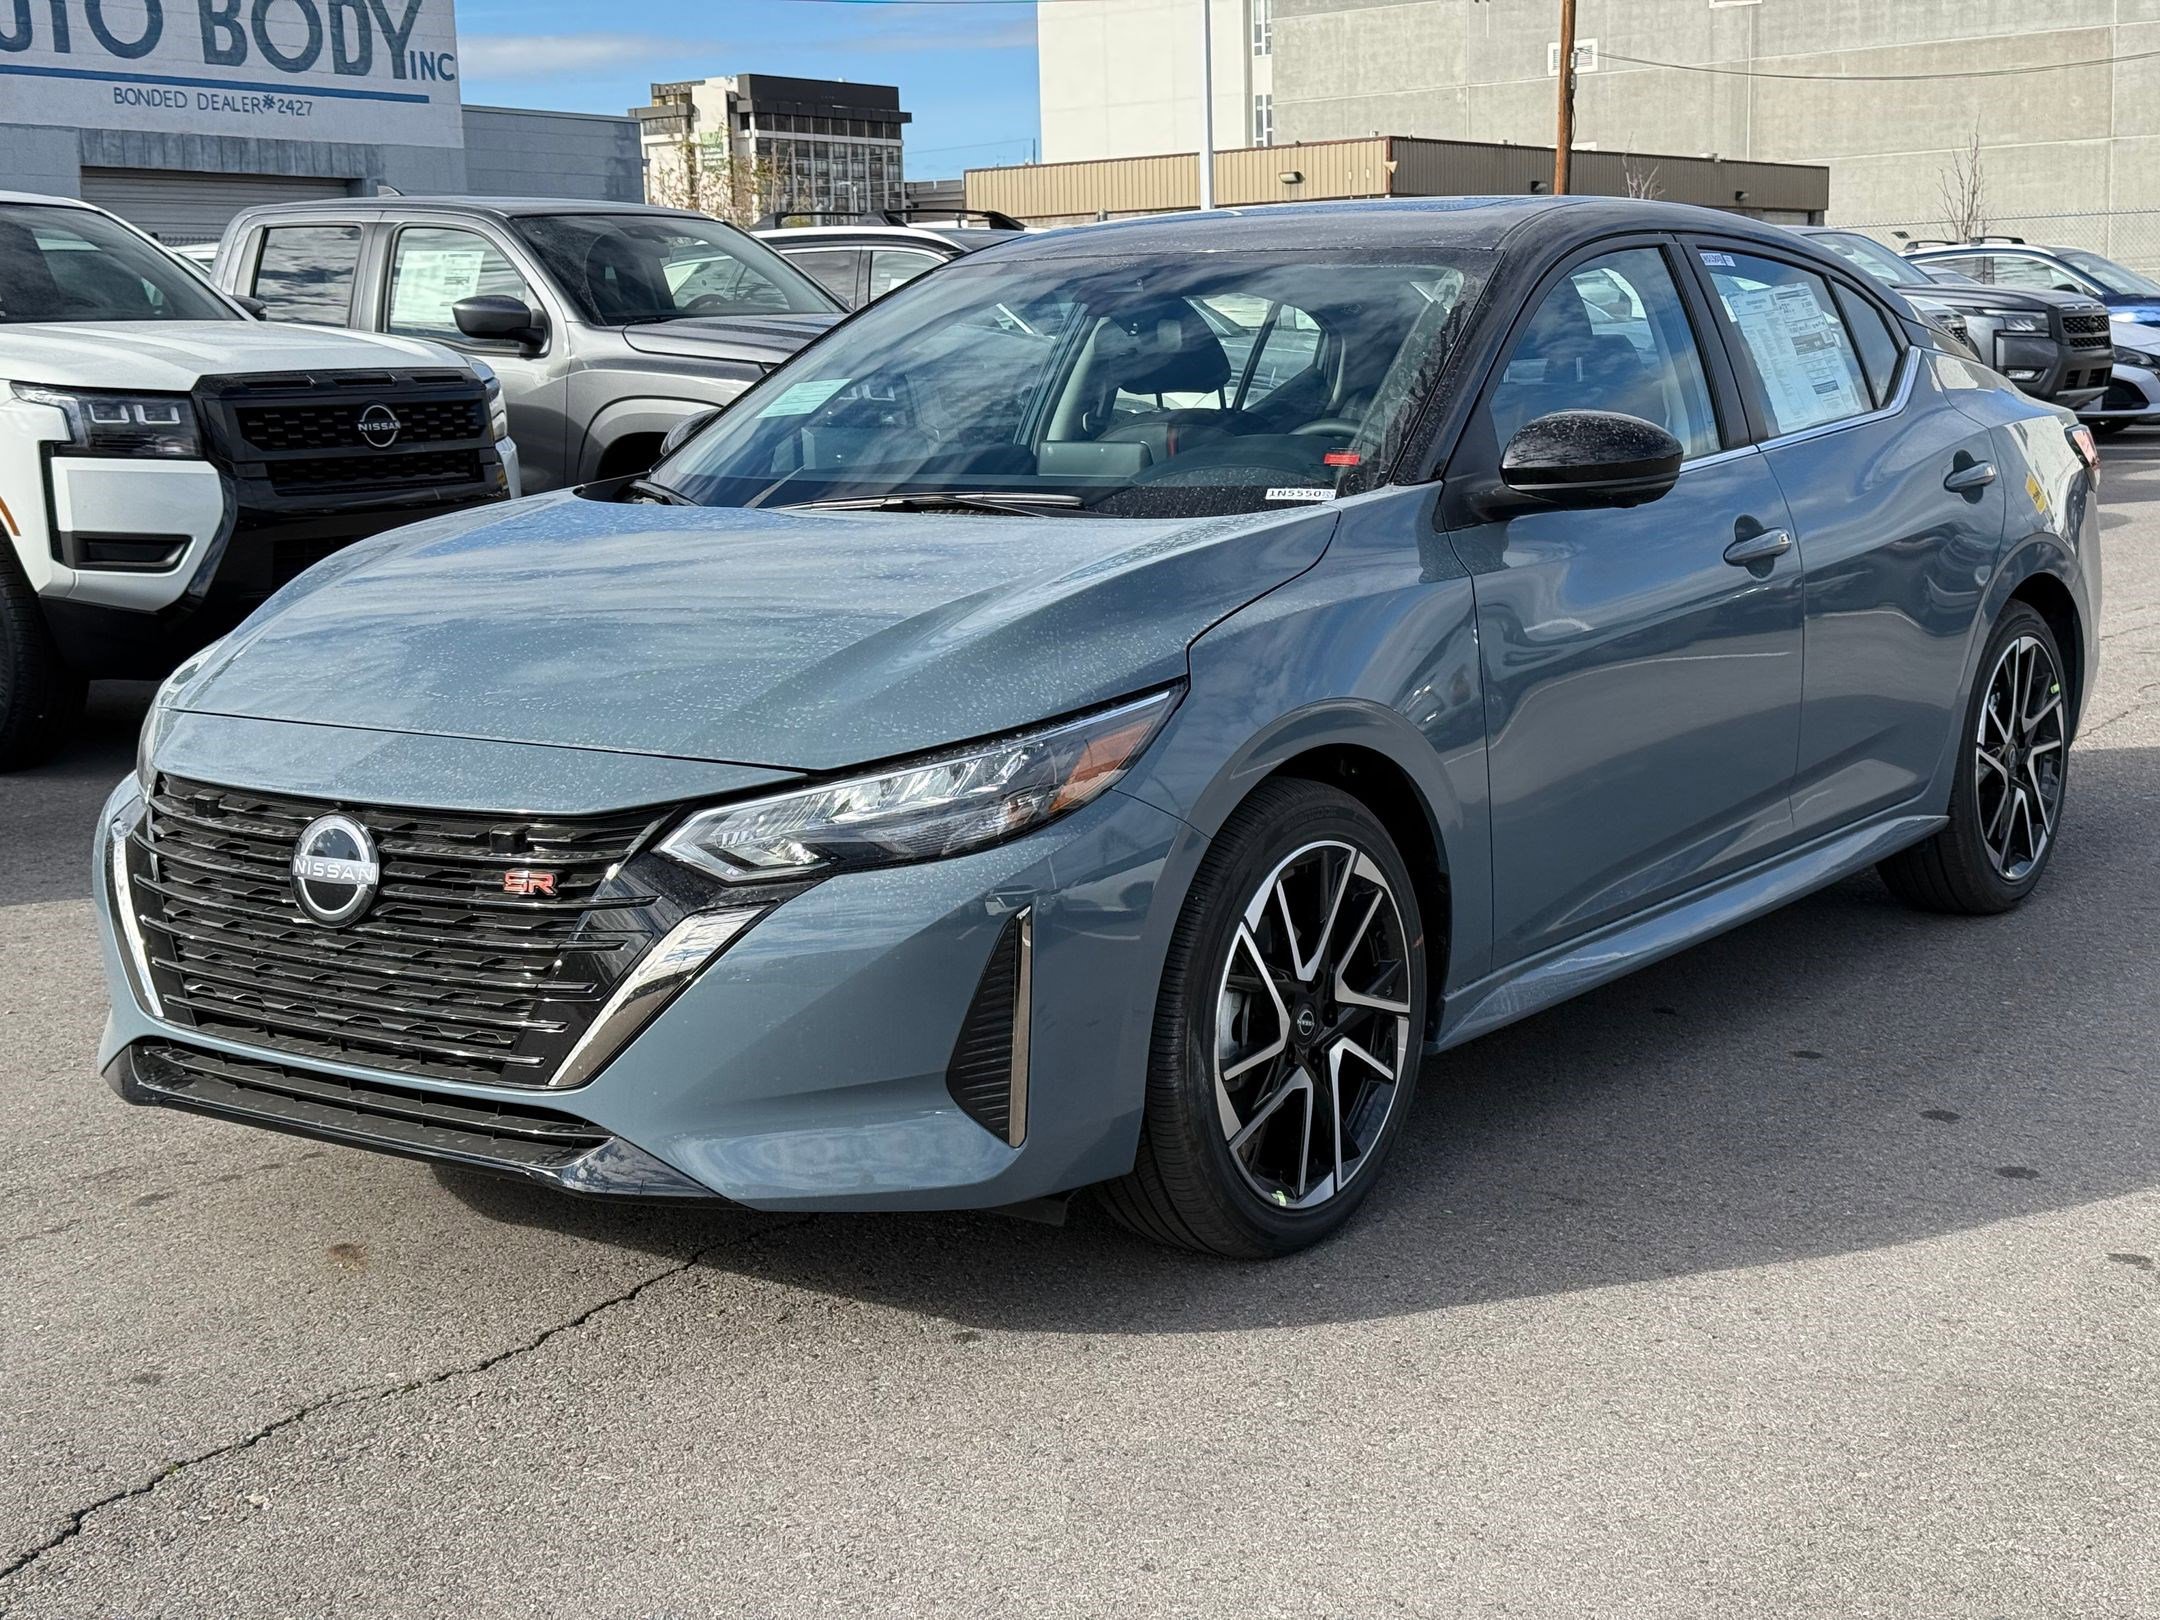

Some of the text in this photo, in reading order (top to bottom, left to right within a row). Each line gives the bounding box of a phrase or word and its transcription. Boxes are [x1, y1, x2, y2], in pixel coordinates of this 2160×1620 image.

[199, 0, 422, 80] BODY
[408, 50, 456, 81] INC
[113, 87, 187, 108] BONDED
[357, 422, 401, 431] NISSAN
[294, 858, 376, 882] NISSAN
[503, 870, 557, 895] SR
